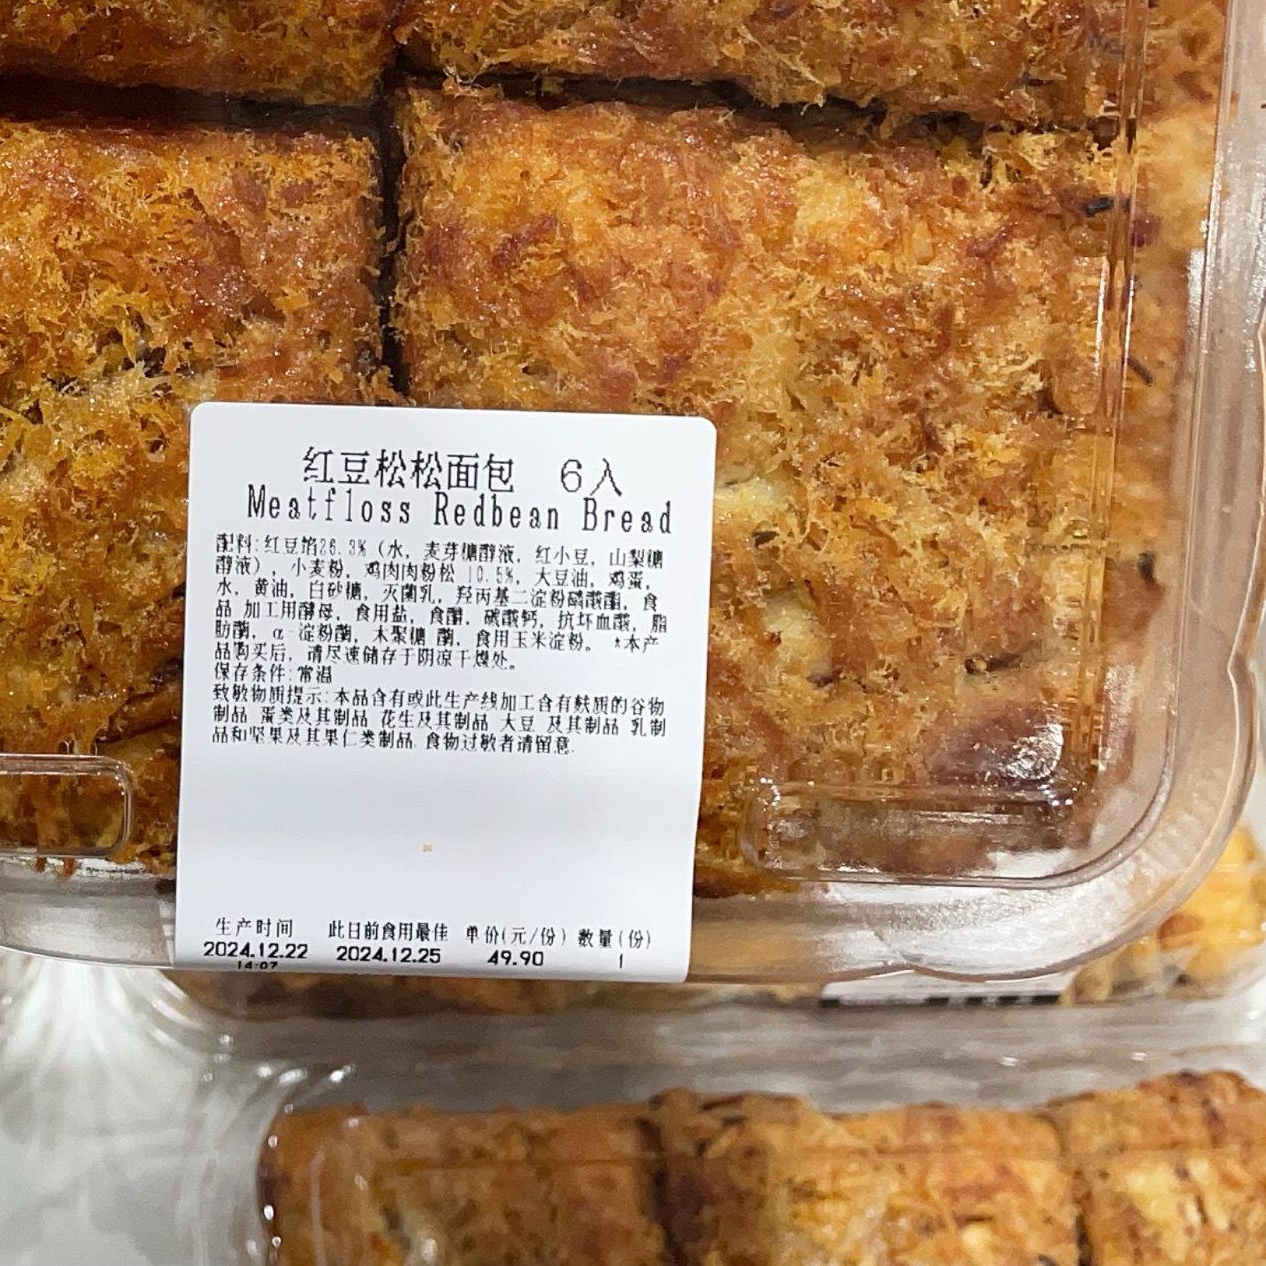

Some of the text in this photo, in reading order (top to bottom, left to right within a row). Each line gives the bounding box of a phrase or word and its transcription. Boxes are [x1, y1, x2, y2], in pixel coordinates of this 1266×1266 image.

[302, 446, 623, 497] 红豆松松面包 6入
[247, 483, 671, 535] Meatfloss Redbean Bread
[215, 916, 294, 938] 生产时间
[328, 919, 448, 943] 此日前食用最佳
[203, 940, 309, 960] 2024.12.22
[336, 945, 442, 964] 2024.12.25
[487, 949, 544, 967] 49.90
